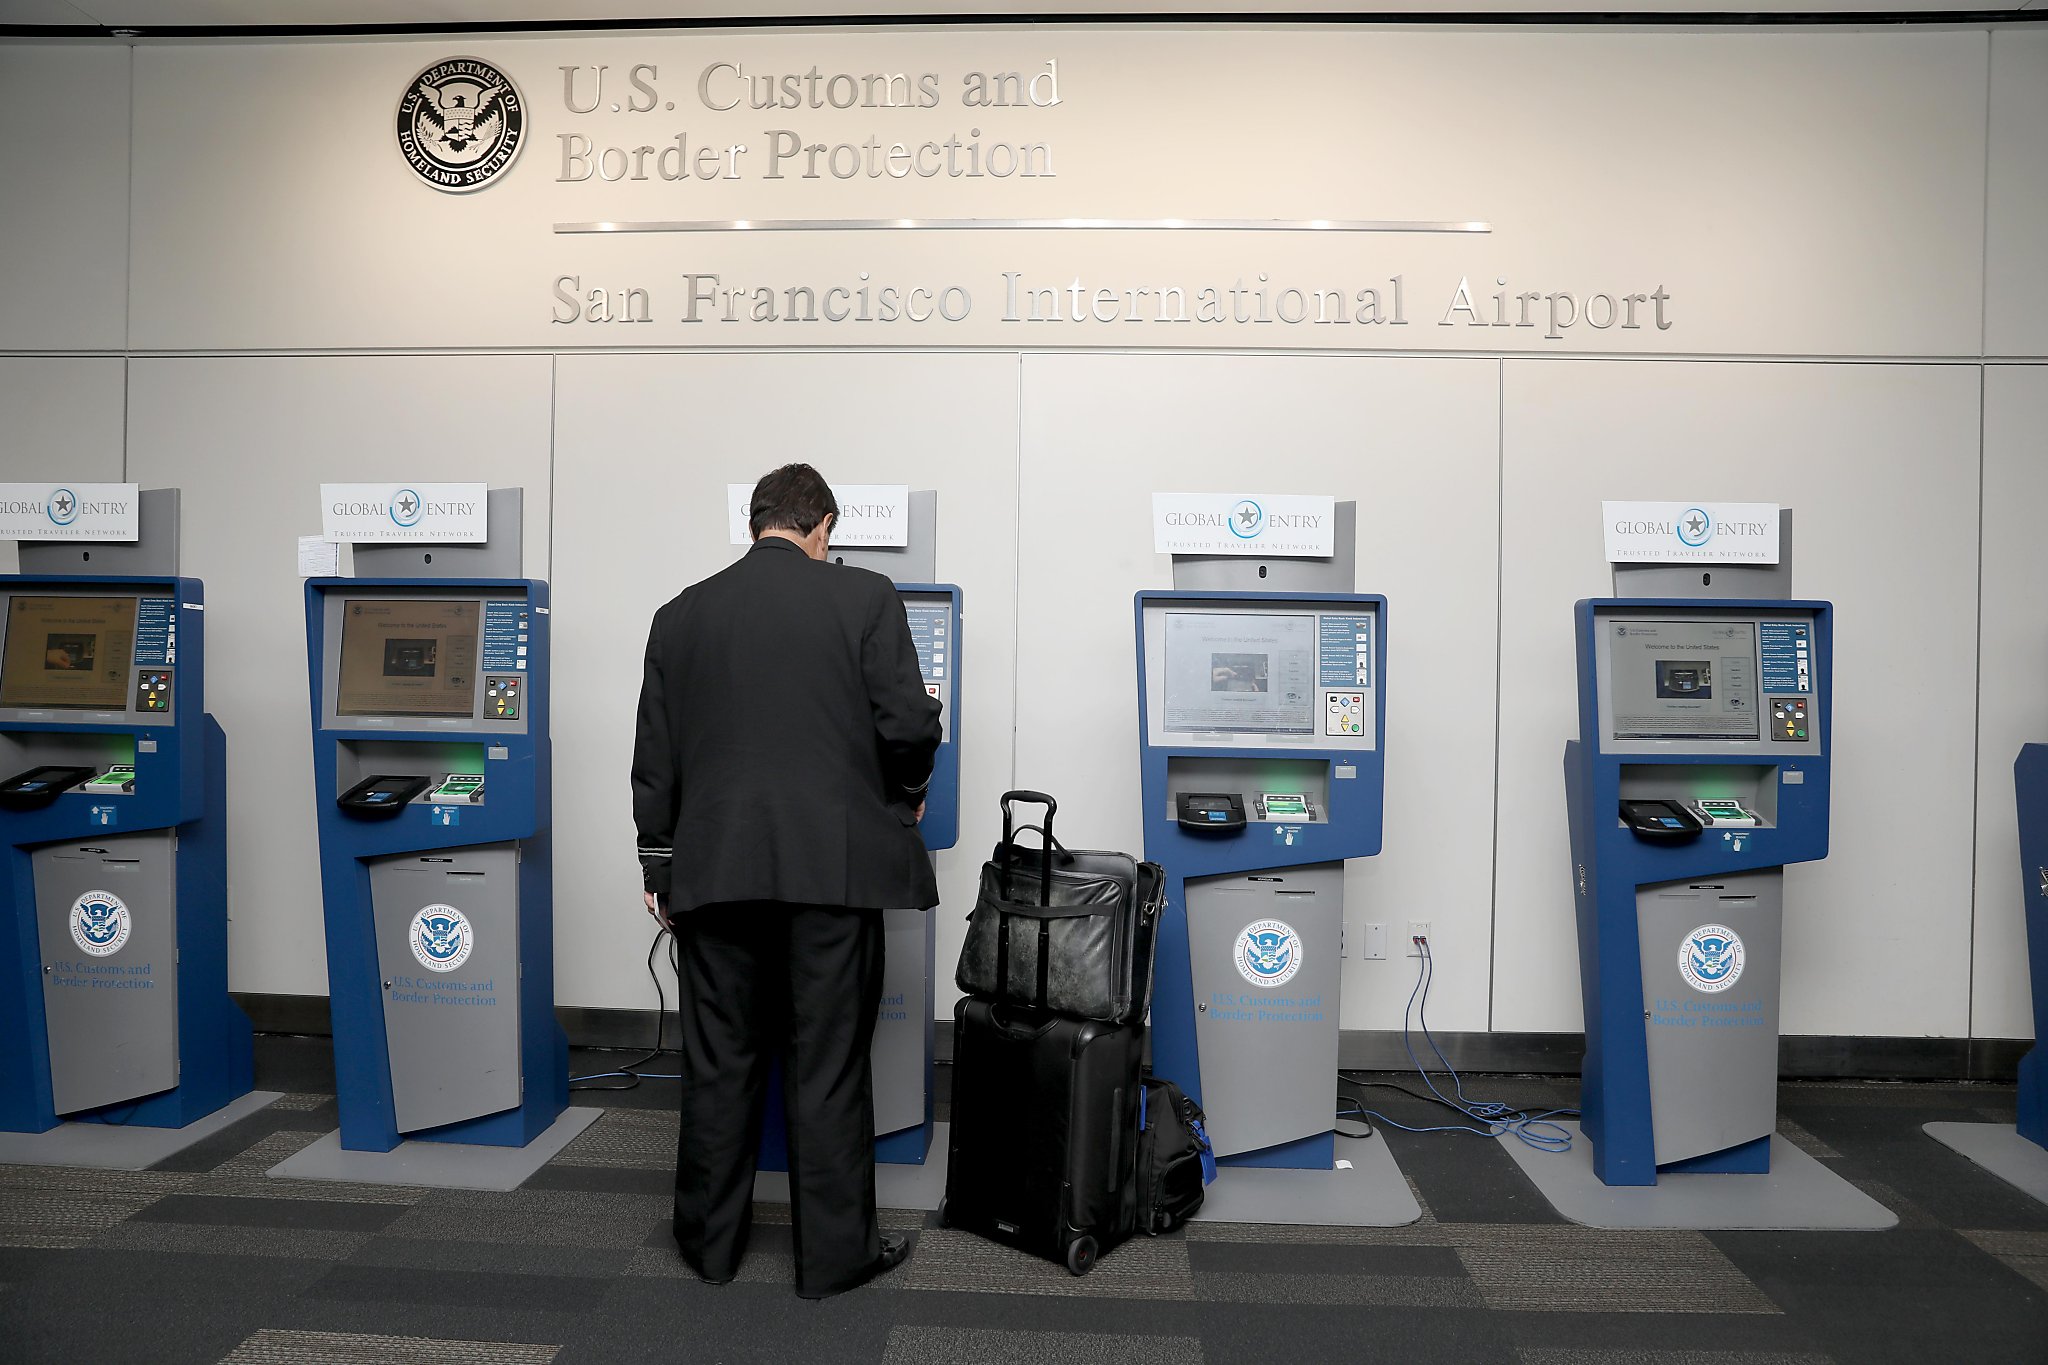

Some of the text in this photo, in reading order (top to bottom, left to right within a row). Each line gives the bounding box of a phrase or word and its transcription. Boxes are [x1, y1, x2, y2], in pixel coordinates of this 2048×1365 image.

[401, 62, 519, 114] U.S. DEPARTMENT OF
[558, 58, 1063, 114] U.S. Customs and
[400, 128, 519, 184] HOMELAND SECURITY
[555, 127, 1057, 183] Border Protection
[552, 271, 1673, 339] San Francisco International Airport
[82, 502, 128, 515] ENTRY
[332, 502, 476, 516] GLOBAL ENTRY
[842, 504, 895, 518] ENTRY
[1165, 512, 1323, 529] GLOBAL ENTRY
[1615, 521, 1768, 536] GLOBAL ENTRY
[75, 962, 125, 975] Customs
[128, 963, 151, 975] and
[53, 975, 154, 989] Border Protection
[416, 978, 467, 991] Customs
[470, 979, 493, 991] and
[392, 990, 497, 1006] Border Protection
